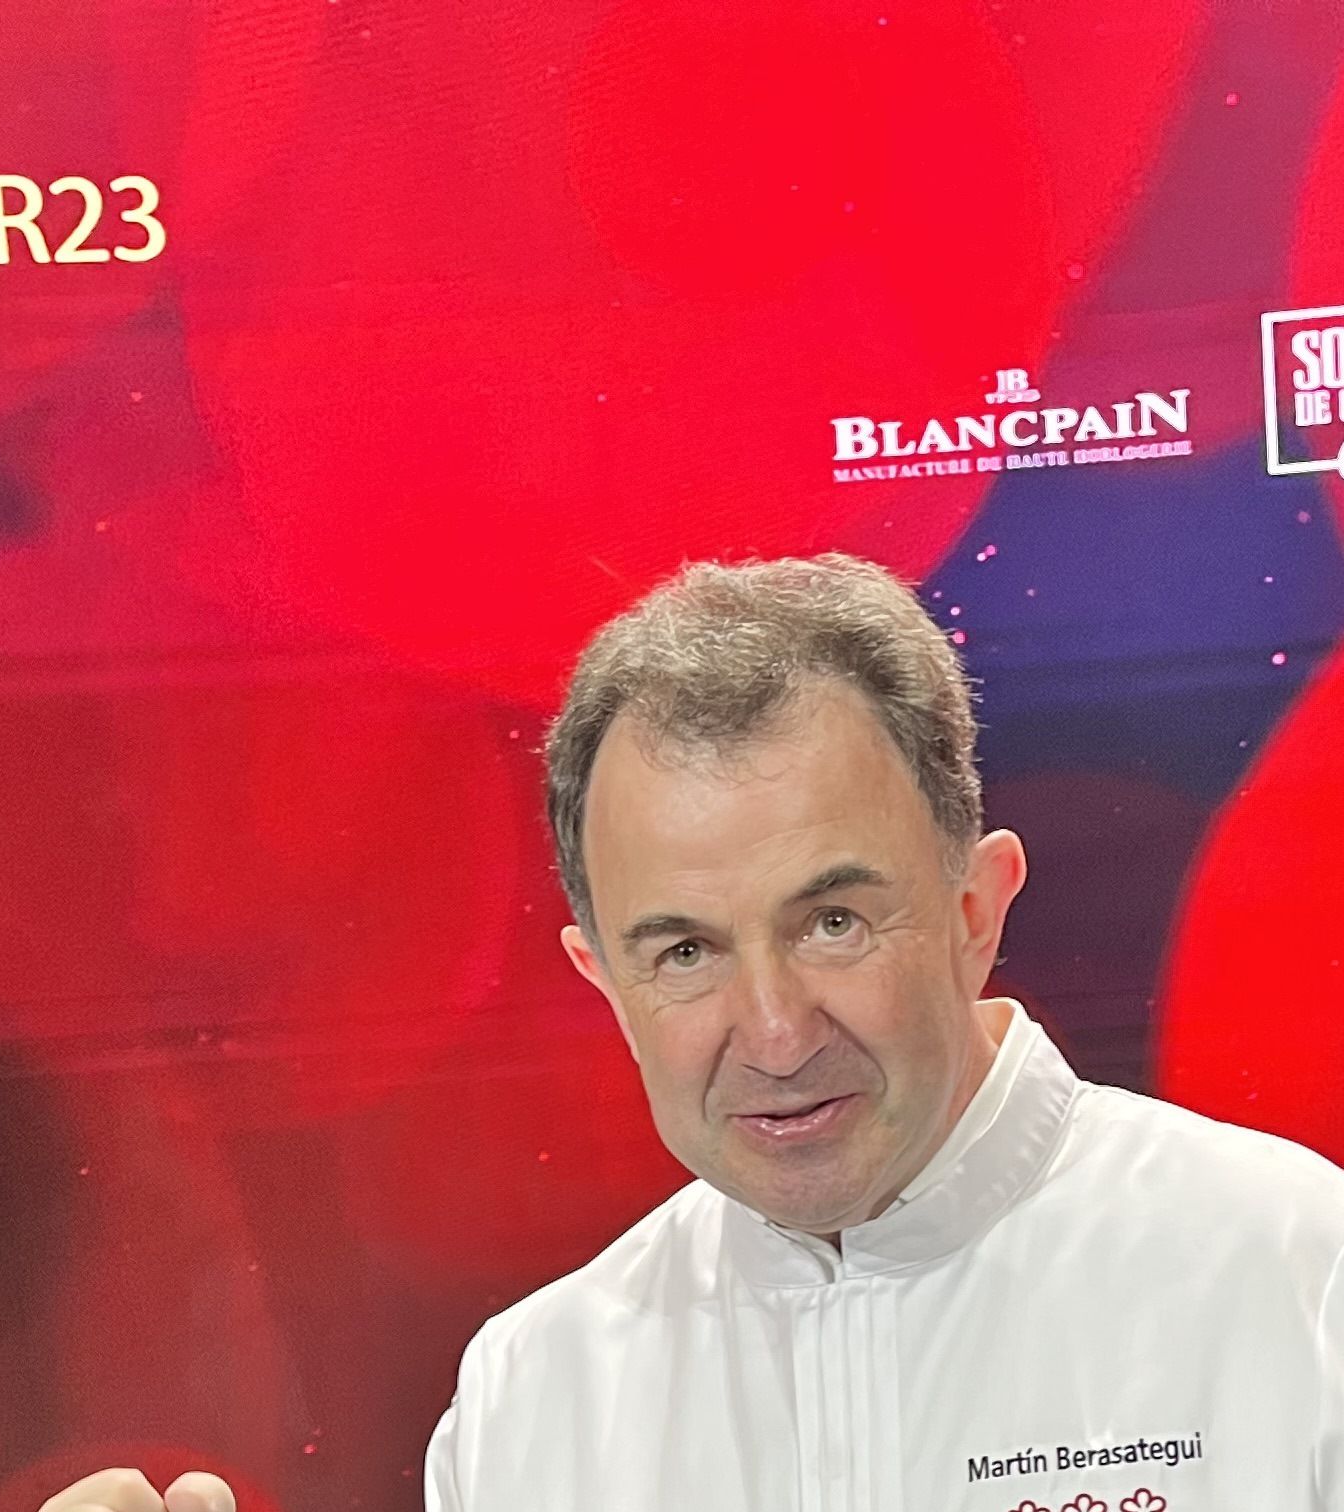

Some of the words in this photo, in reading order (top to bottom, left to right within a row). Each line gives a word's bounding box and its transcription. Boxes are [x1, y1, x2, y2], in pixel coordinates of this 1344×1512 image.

[830, 388, 1191, 461] BLANCPAIN
[1295, 389, 1332, 426] DE
[968, 1447, 1047, 1482] Martín
[1056, 1432, 1203, 1470] Berasategui
